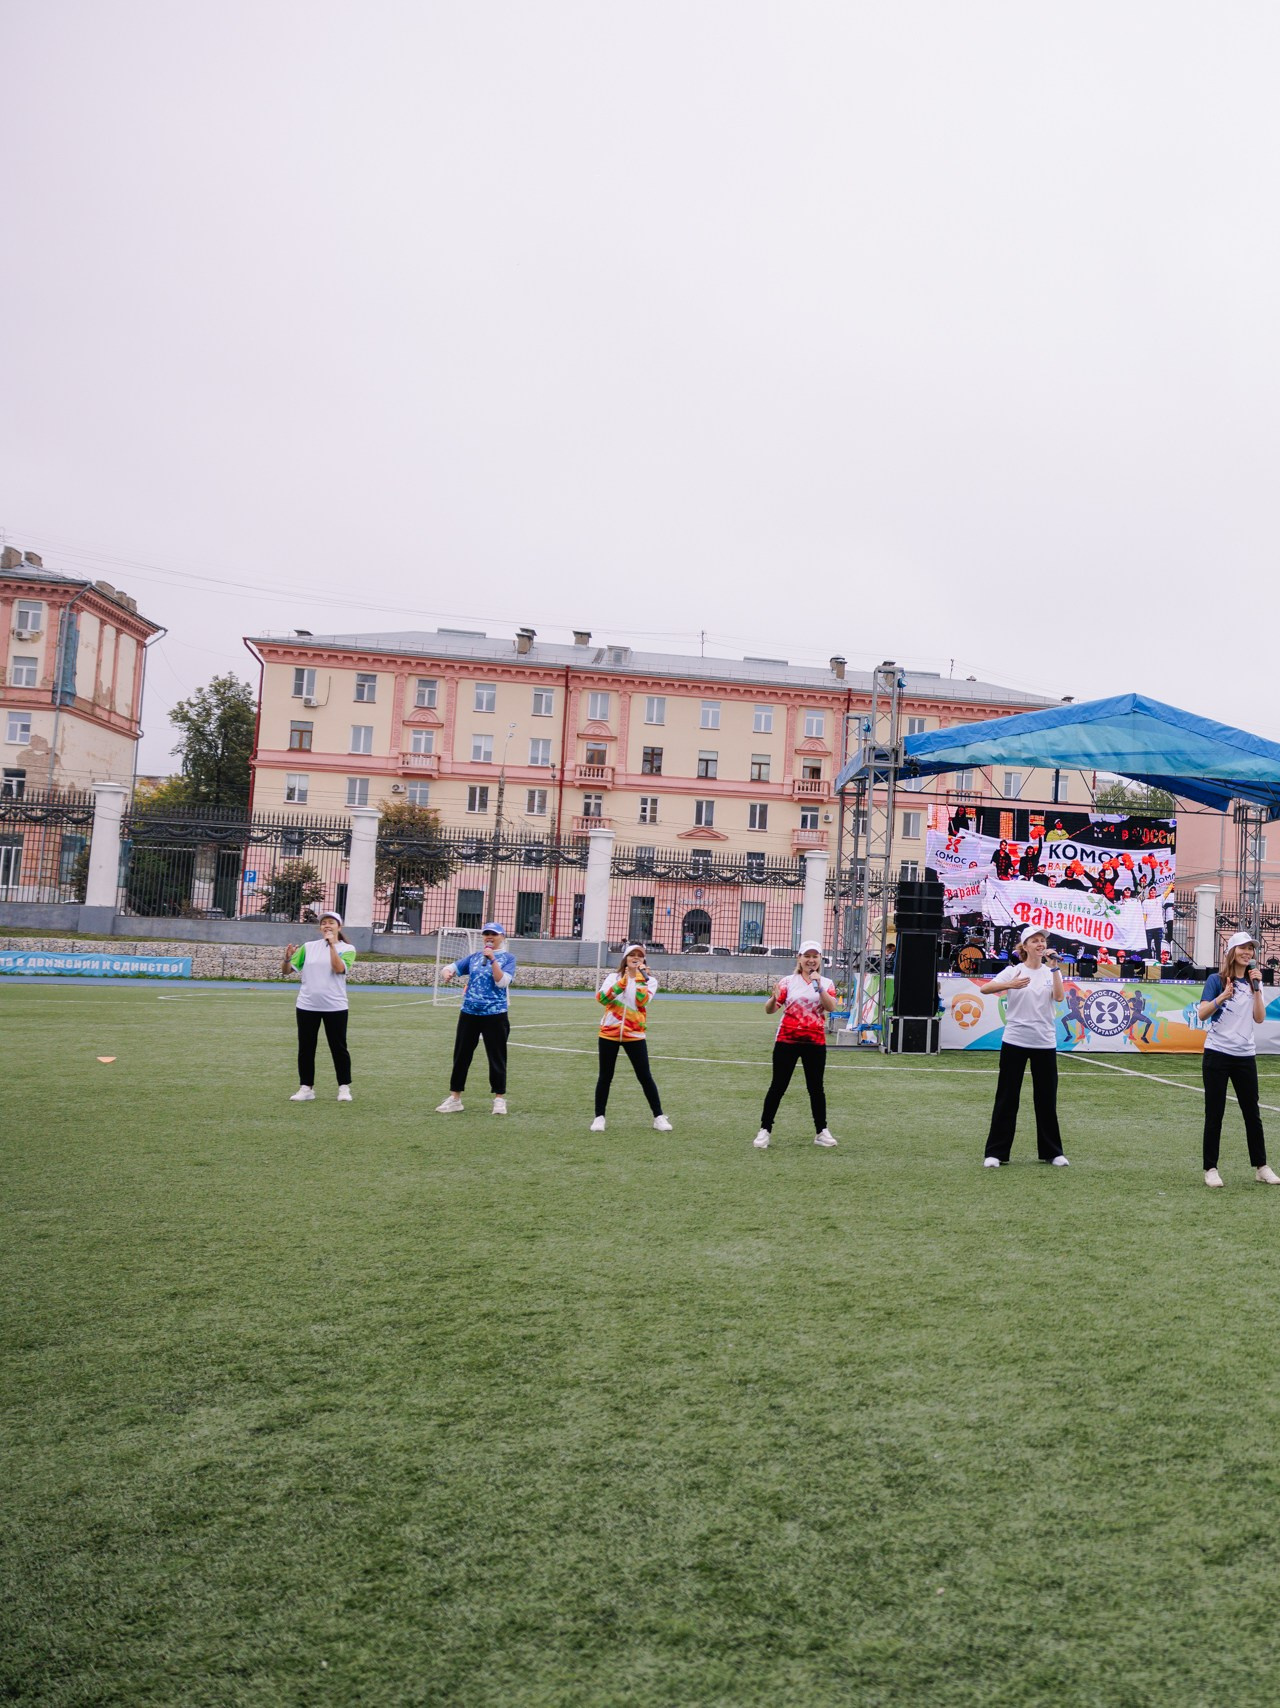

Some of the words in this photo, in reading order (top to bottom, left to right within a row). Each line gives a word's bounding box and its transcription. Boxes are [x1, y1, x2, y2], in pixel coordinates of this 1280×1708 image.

[246, 871, 255, 881] P
[1013, 902, 1114, 942] Вараксино
[27, 957, 100, 970] движении
[113, 961, 184, 973] единстве!
[1087, 991, 1107, 1005] КОМОС
[1108, 991, 1127, 1006] ГРУПП
[1087, 1019, 1128, 1036] СПАРТАКИАДА
